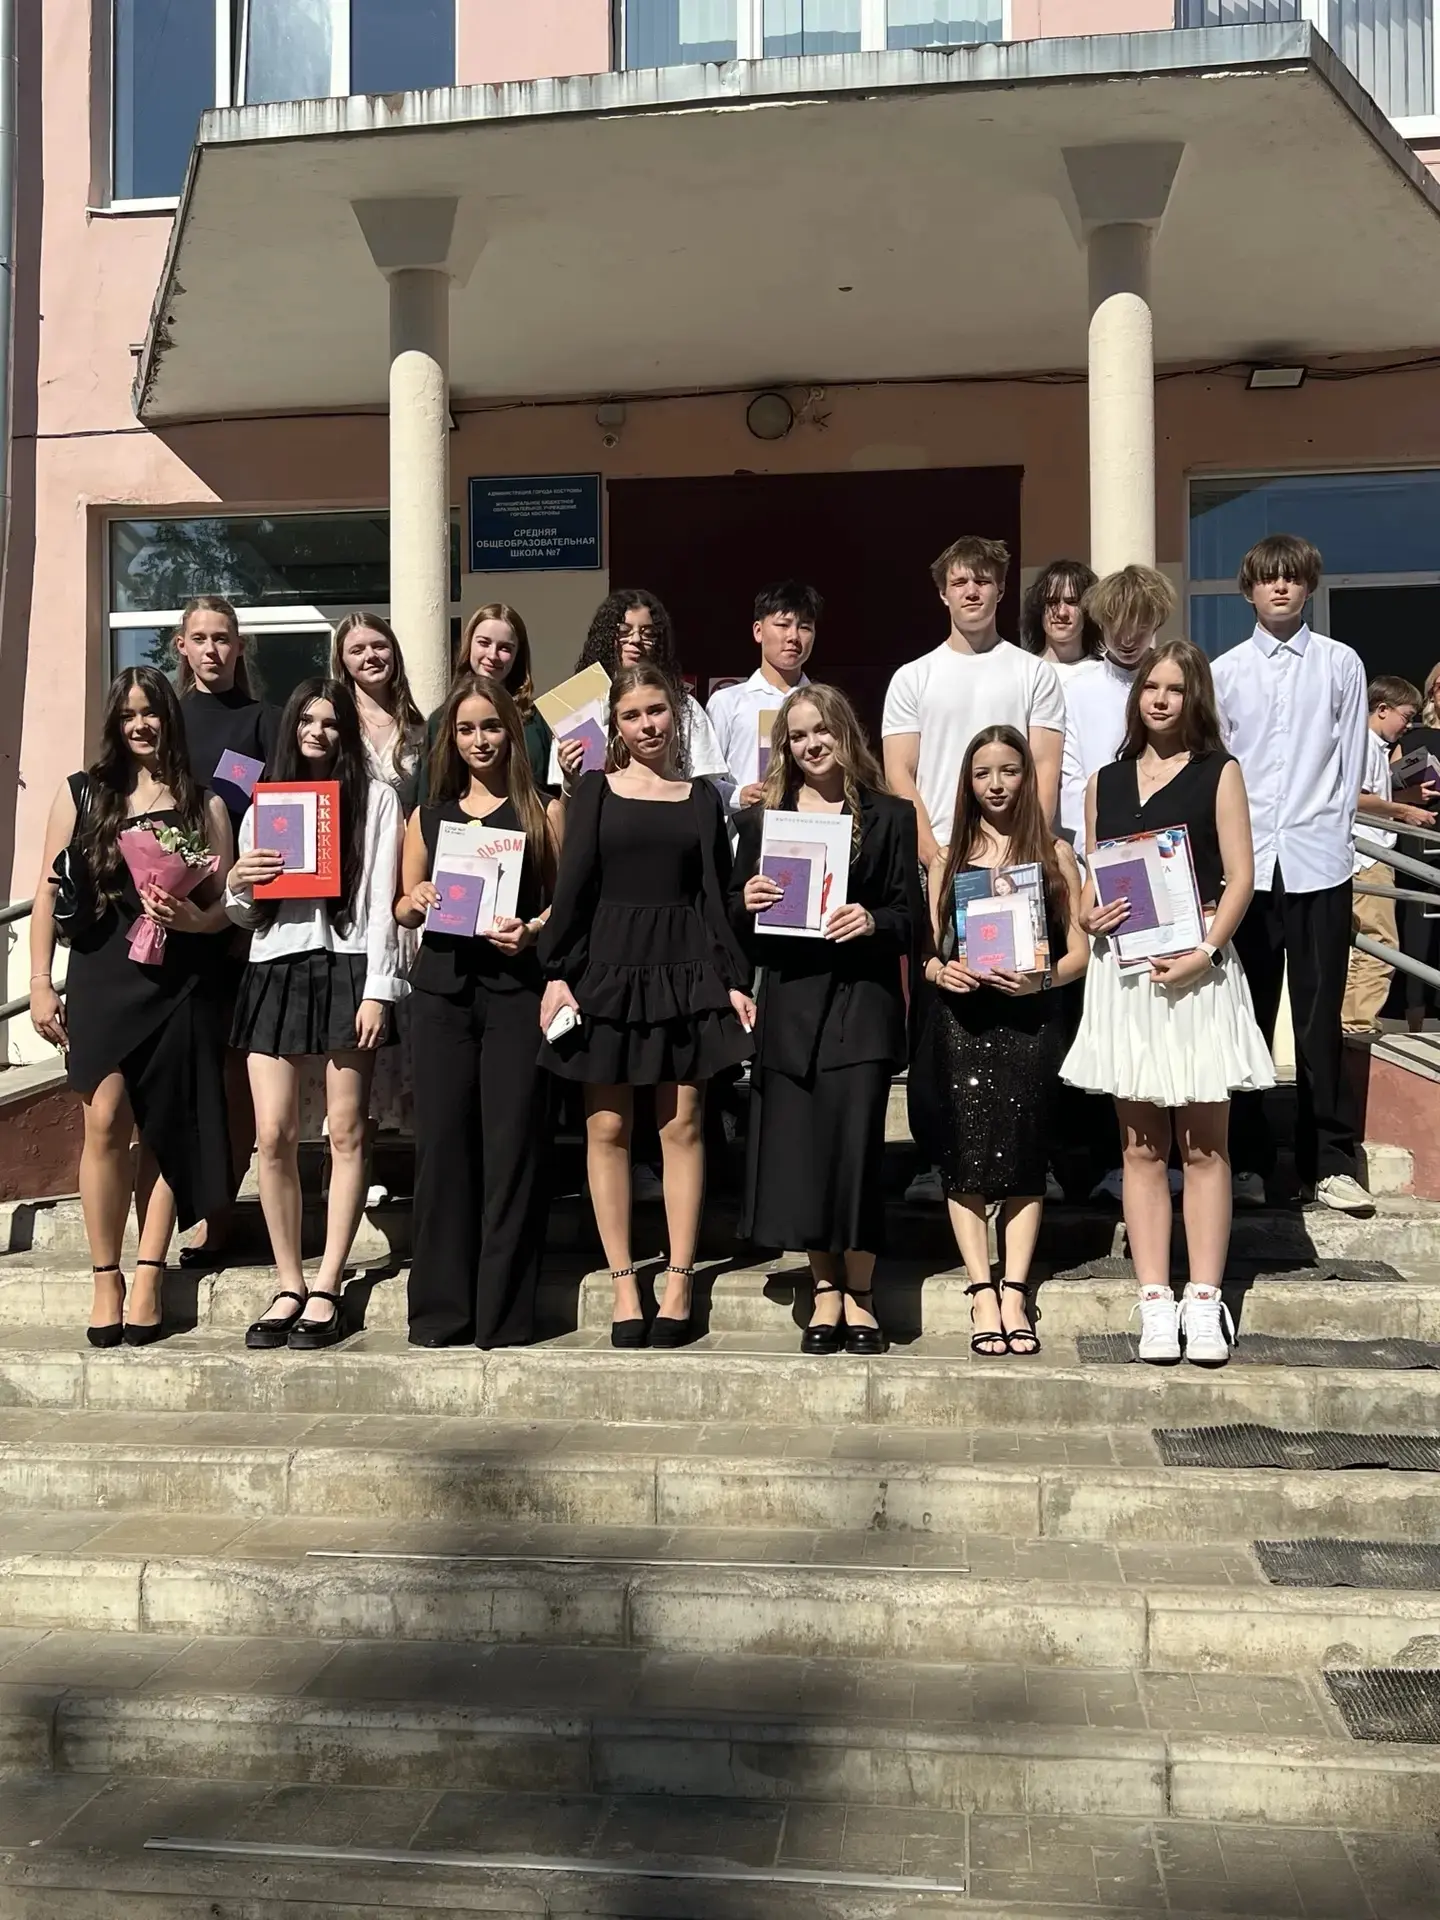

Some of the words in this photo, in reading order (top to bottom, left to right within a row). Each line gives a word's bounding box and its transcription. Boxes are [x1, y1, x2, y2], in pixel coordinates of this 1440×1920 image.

[513, 528, 557, 537] СРЕДНЯЯ
[476, 537, 595, 549] ОБЩЕОБРАЗОВАТЕЛЬНАЯ
[510, 548, 544, 557] ШКОЛА
[546, 548, 561, 556] №7
[476, 838, 523, 858] ЛЬБОМ
